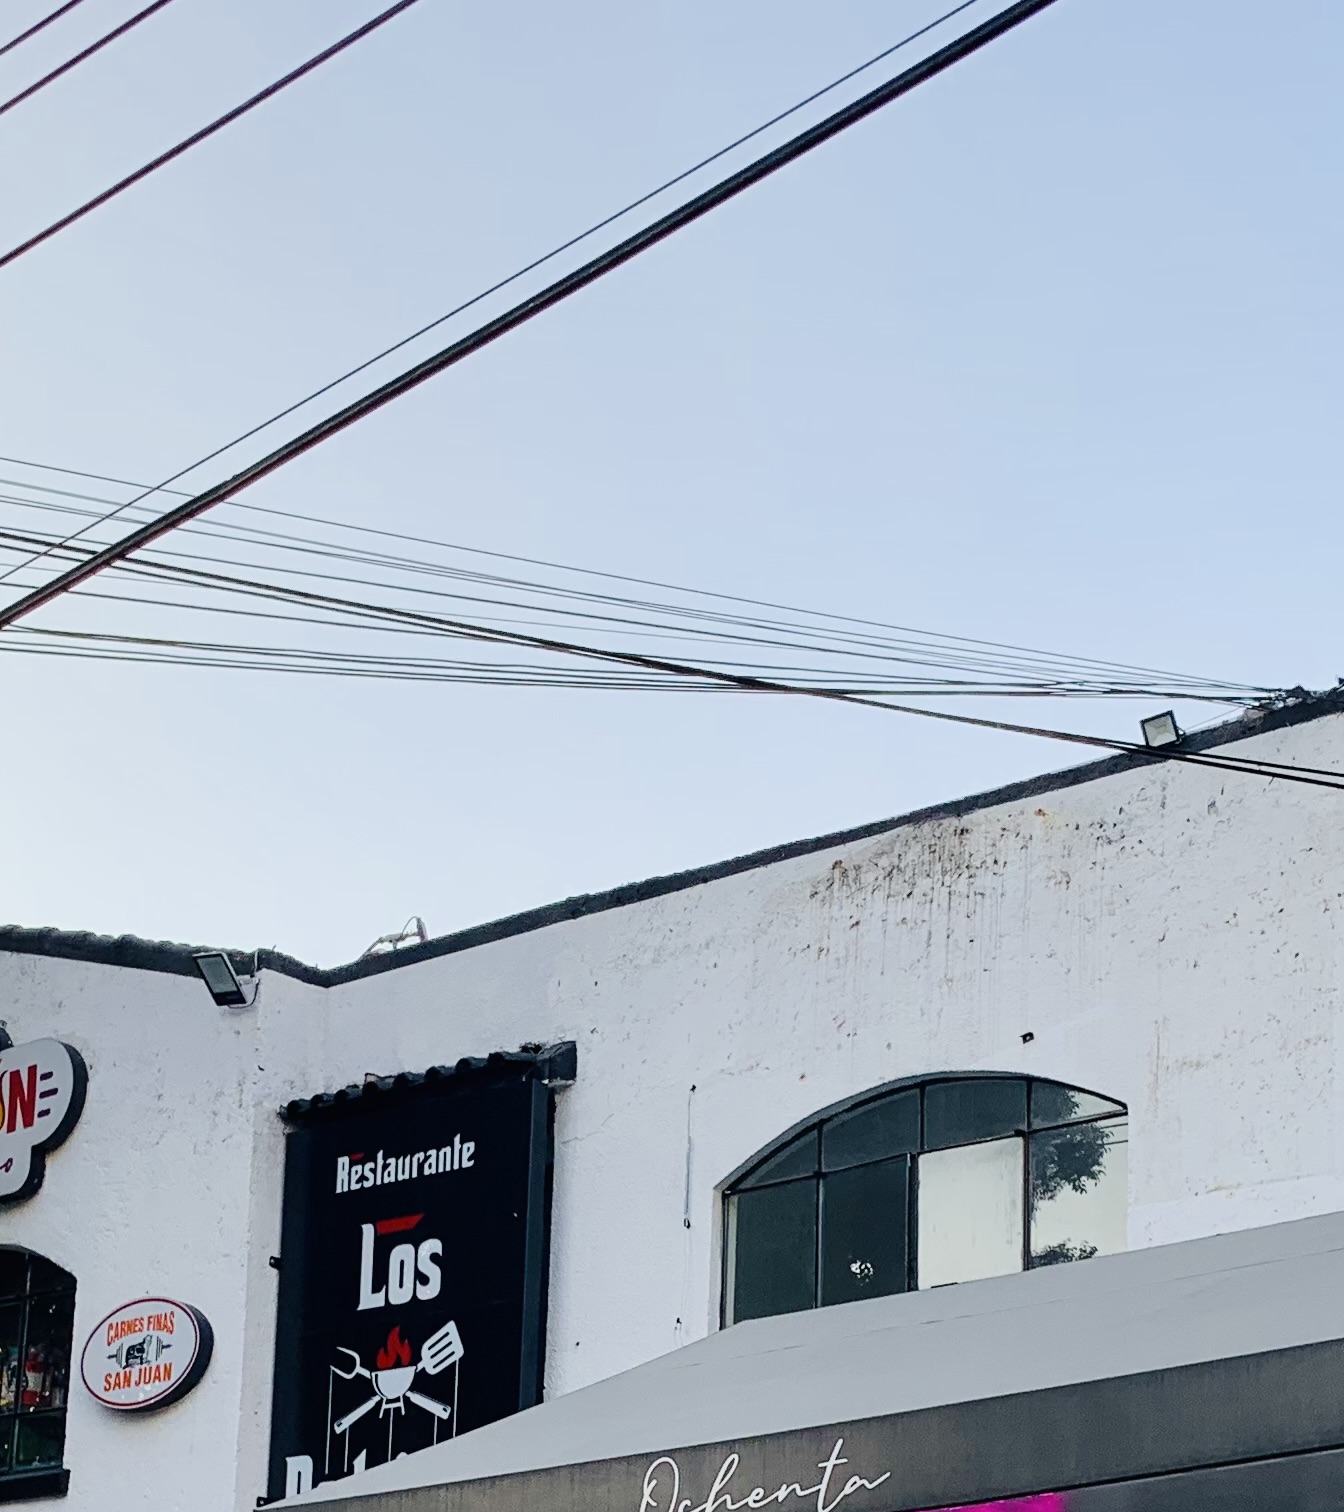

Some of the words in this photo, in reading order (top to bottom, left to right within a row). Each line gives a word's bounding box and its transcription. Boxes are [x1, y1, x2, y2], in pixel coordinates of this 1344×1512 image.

[335, 1132, 476, 1194] Restaurante
[356, 1216, 444, 1312] Los
[106, 1316, 145, 1347] CARNES
[146, 1310, 175, 1335] FINAS
[103, 1369, 132, 1393] SAN
[134, 1362, 173, 1388] JUAN
